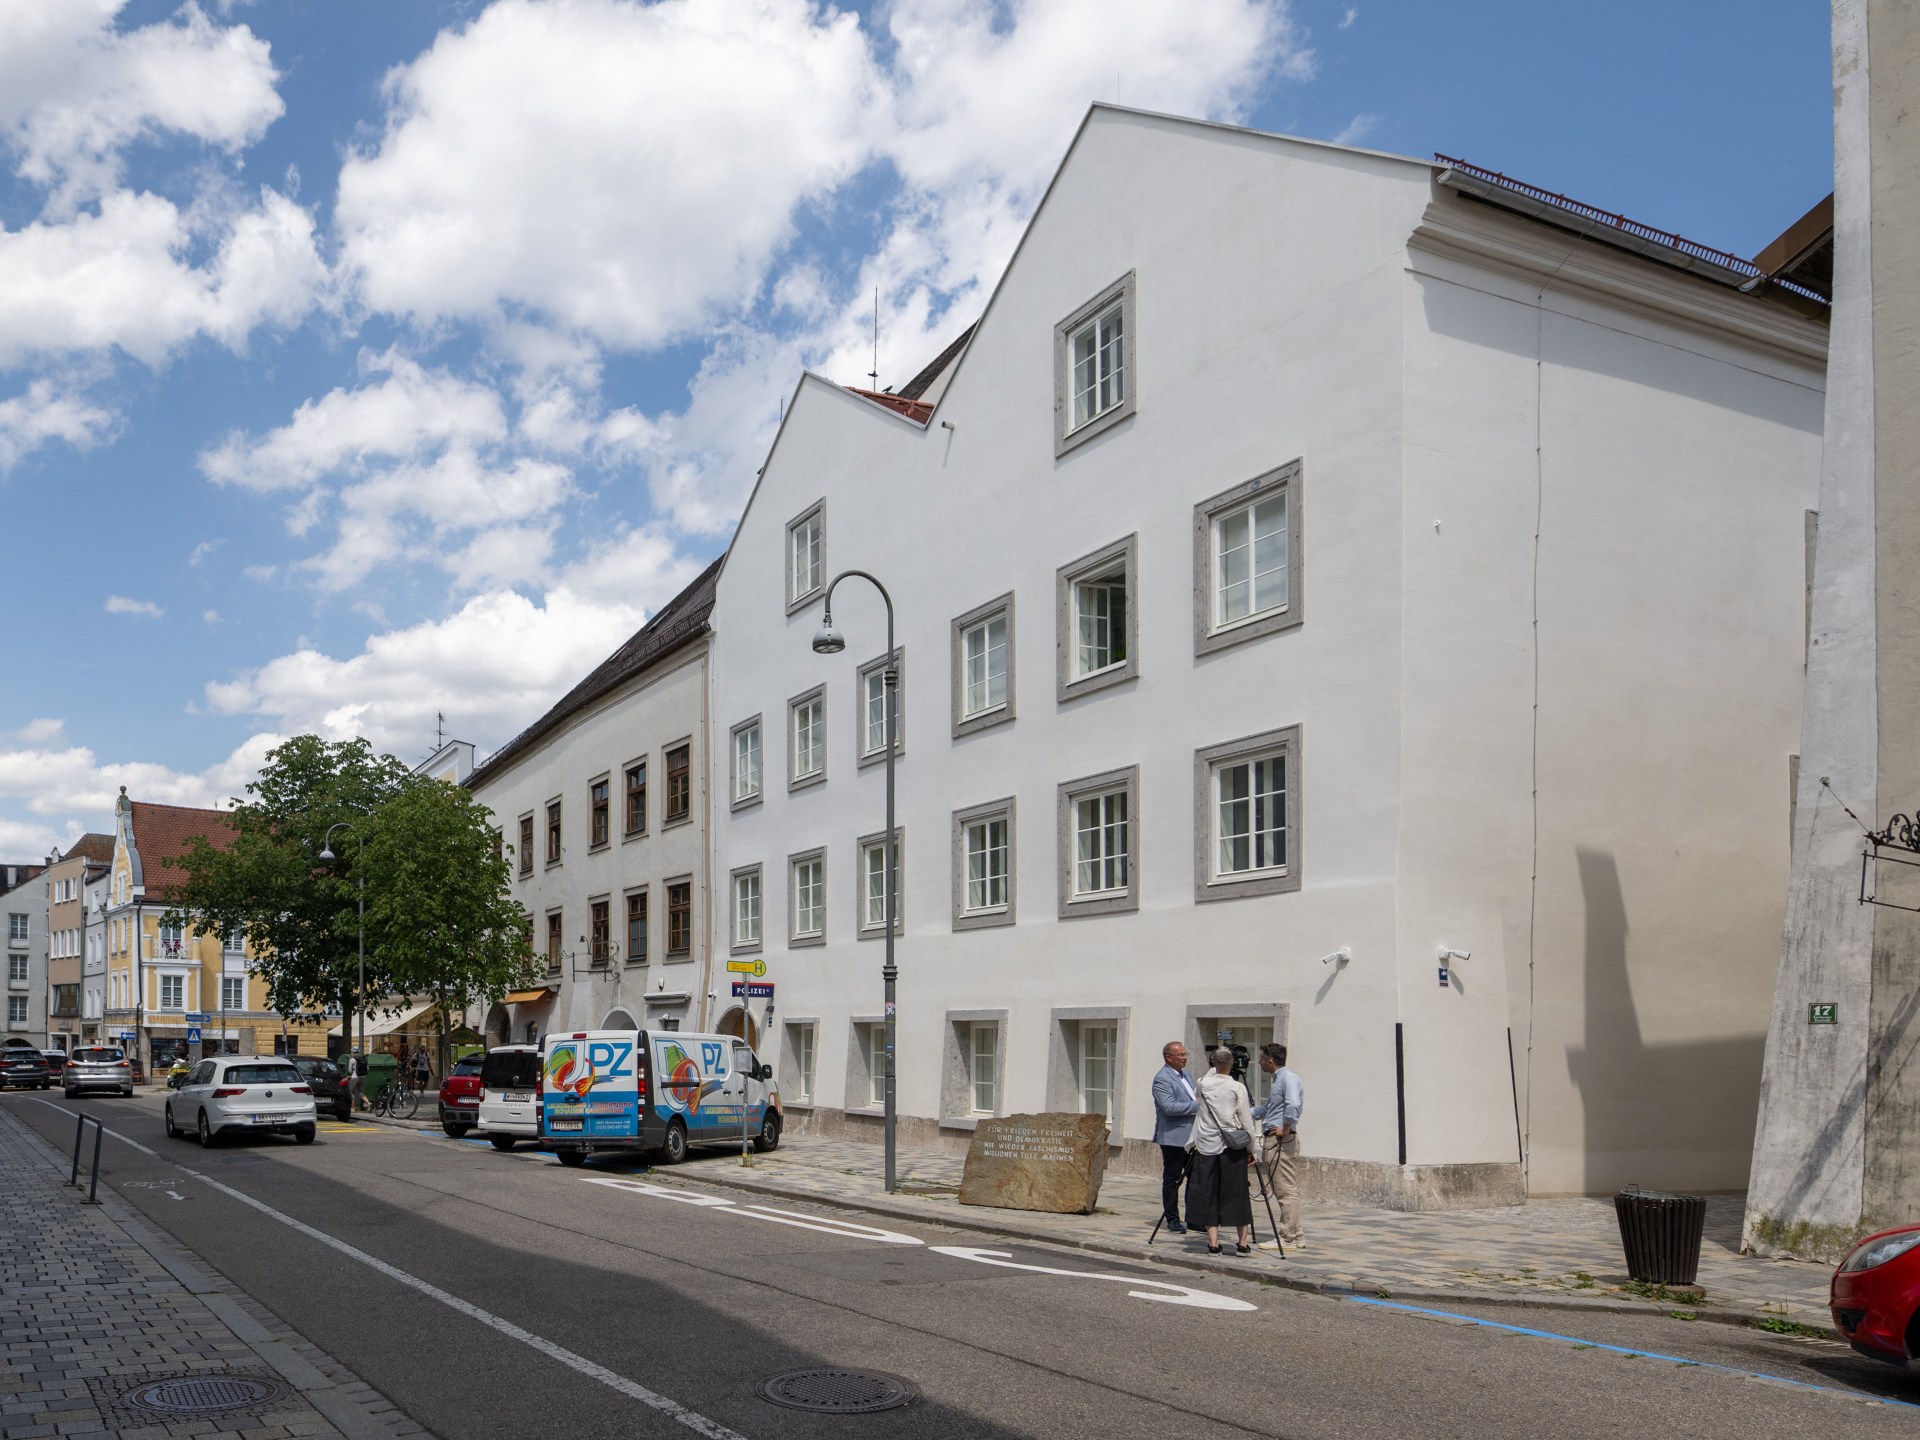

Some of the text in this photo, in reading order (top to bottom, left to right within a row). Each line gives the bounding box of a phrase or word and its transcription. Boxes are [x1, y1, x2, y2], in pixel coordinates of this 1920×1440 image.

[755, 963, 762, 973] H
[1813, 1005, 1832, 1016] 17
[987, 1124, 1002, 1133] FÜR
[1040, 1129, 1074, 1137] FREIHEIT
[997, 1134, 1062, 1144] UND DEMOKRATIE
[984, 1141, 995, 1149] NIE
[998, 1142, 1025, 1151] WIEDER
[983, 1150, 1074, 1162] MILLIONEN TOTE MAHNEN
